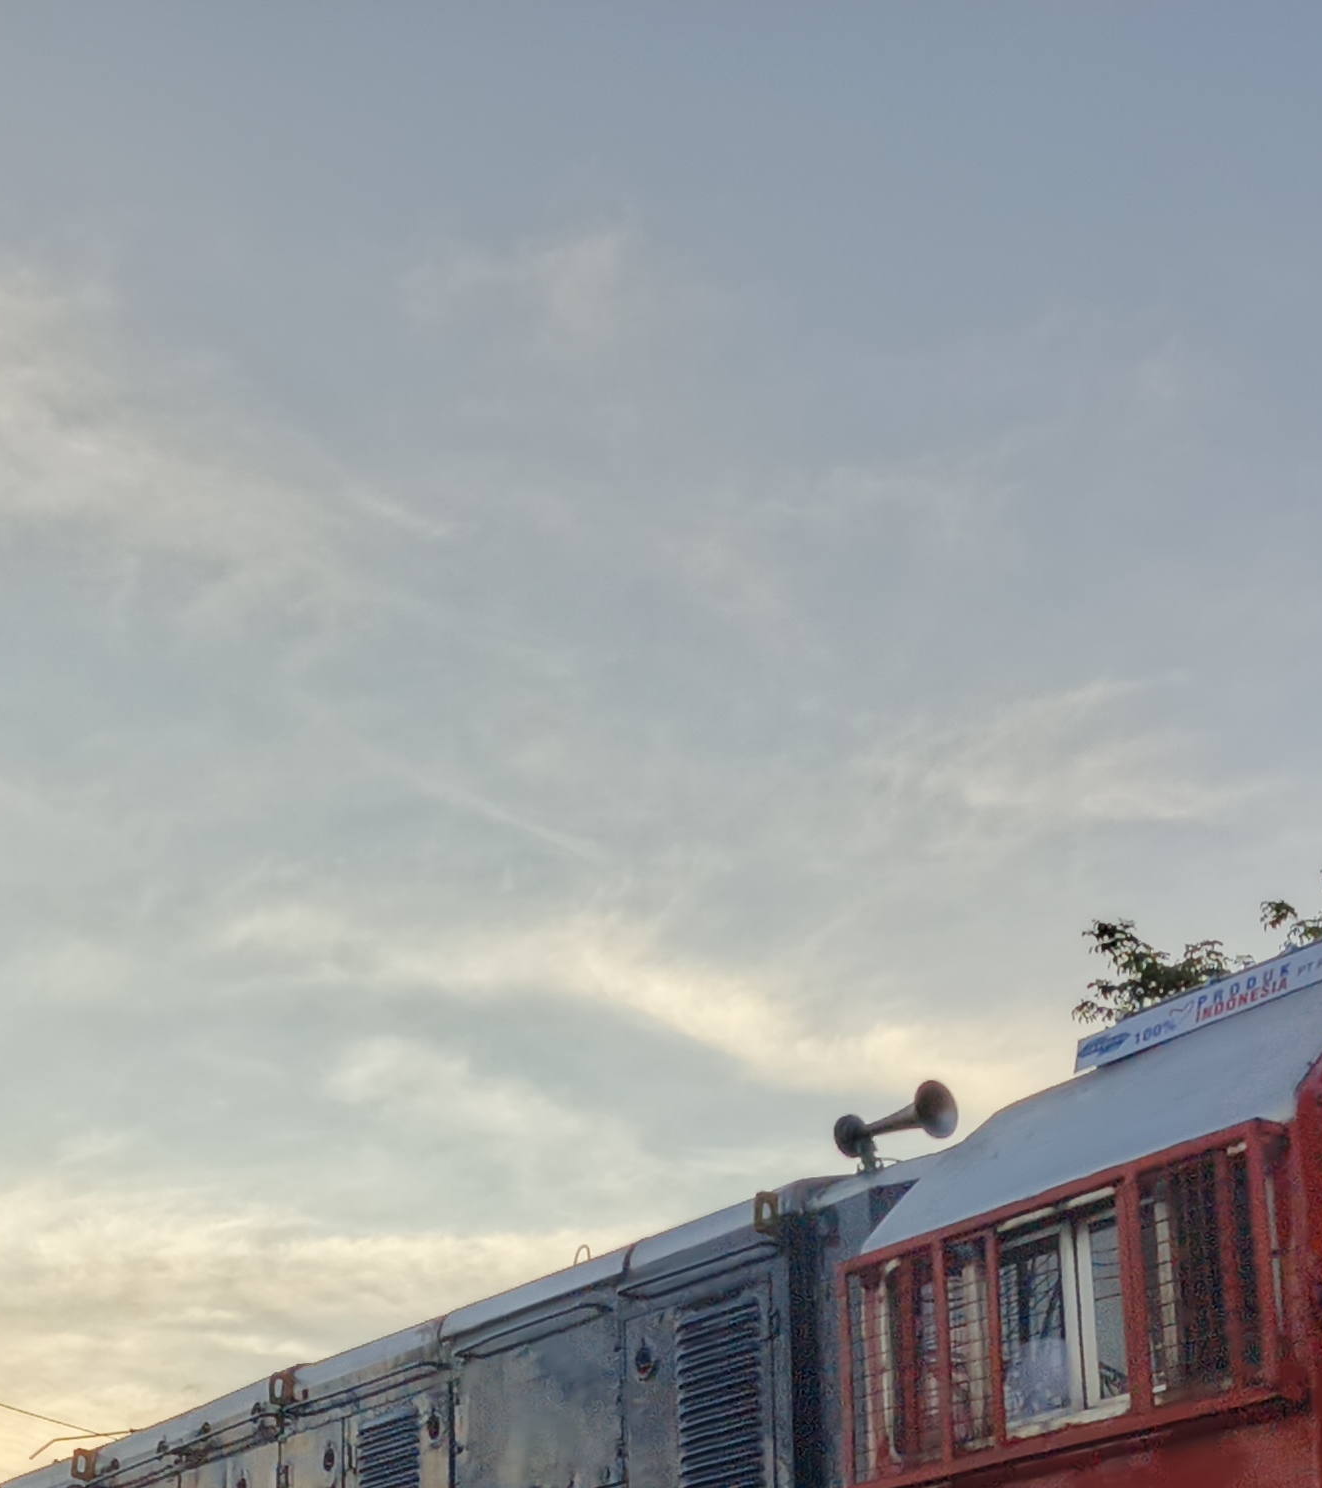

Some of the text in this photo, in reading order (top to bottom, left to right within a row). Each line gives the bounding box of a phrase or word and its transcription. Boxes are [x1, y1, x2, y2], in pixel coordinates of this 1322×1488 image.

[1195, 977, 1288, 1024] INDONESIA
[1197, 963, 1291, 1010] PRODUK
[1134, 1020, 1176, 1045] 100%
